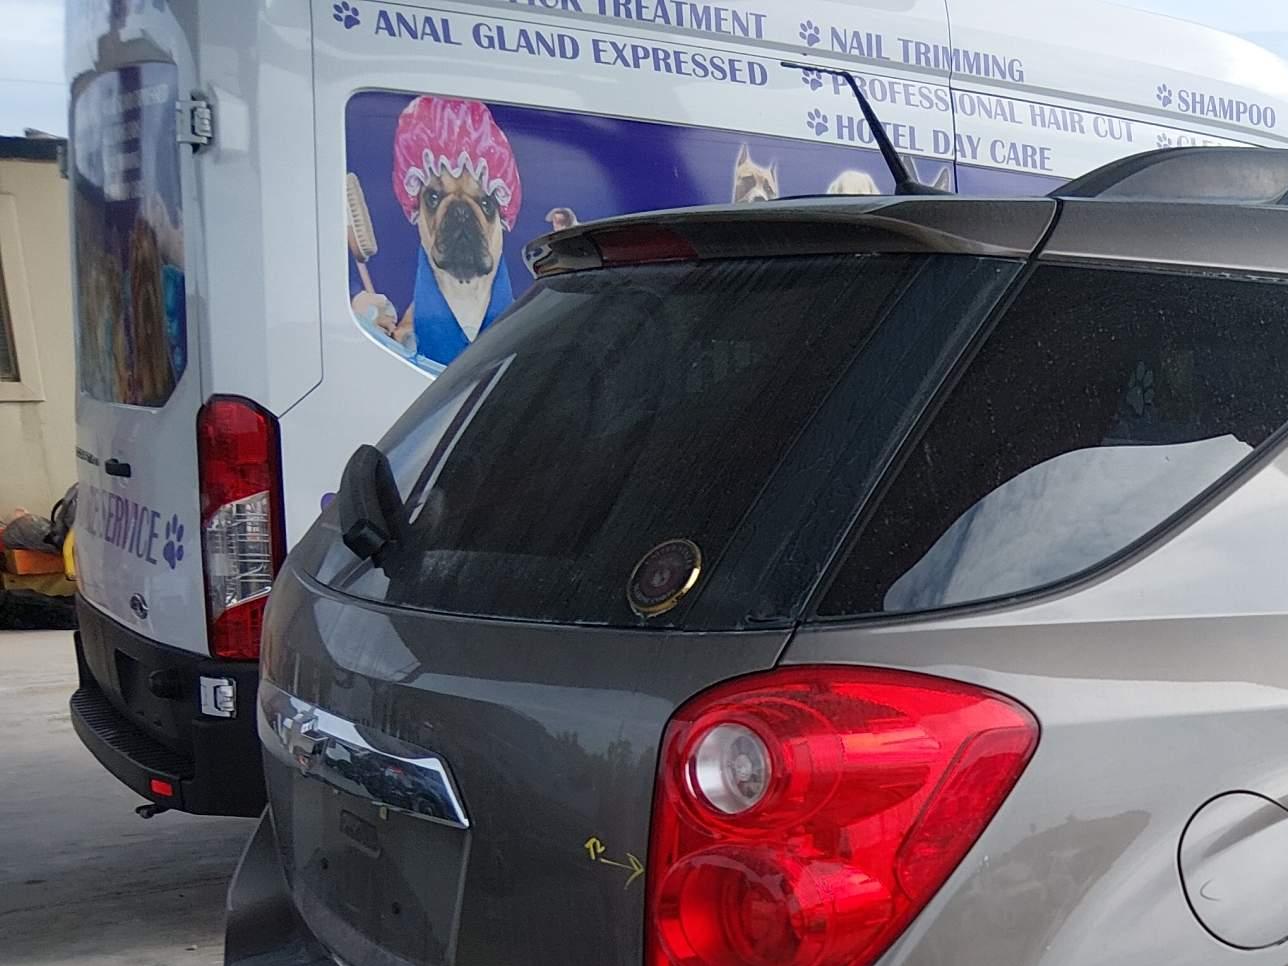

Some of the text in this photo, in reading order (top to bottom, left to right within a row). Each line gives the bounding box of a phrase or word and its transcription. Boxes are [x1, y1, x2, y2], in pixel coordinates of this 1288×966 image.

[374, 9, 768, 87] ANAL GLAND EXPRESSED
[598, 0, 767, 40] TREATMENT
[830, 26, 1025, 83] NAIL TRIMMING
[831, 73, 1023, 124] PROFESSIONAL
[1028, 103, 1086, 135] HAIR
[1092, 115, 1136, 143] CUT
[1176, 89, 1276, 129] SHAMPOO
[835, 114, 1054, 173] HOTEL DAY CARE
